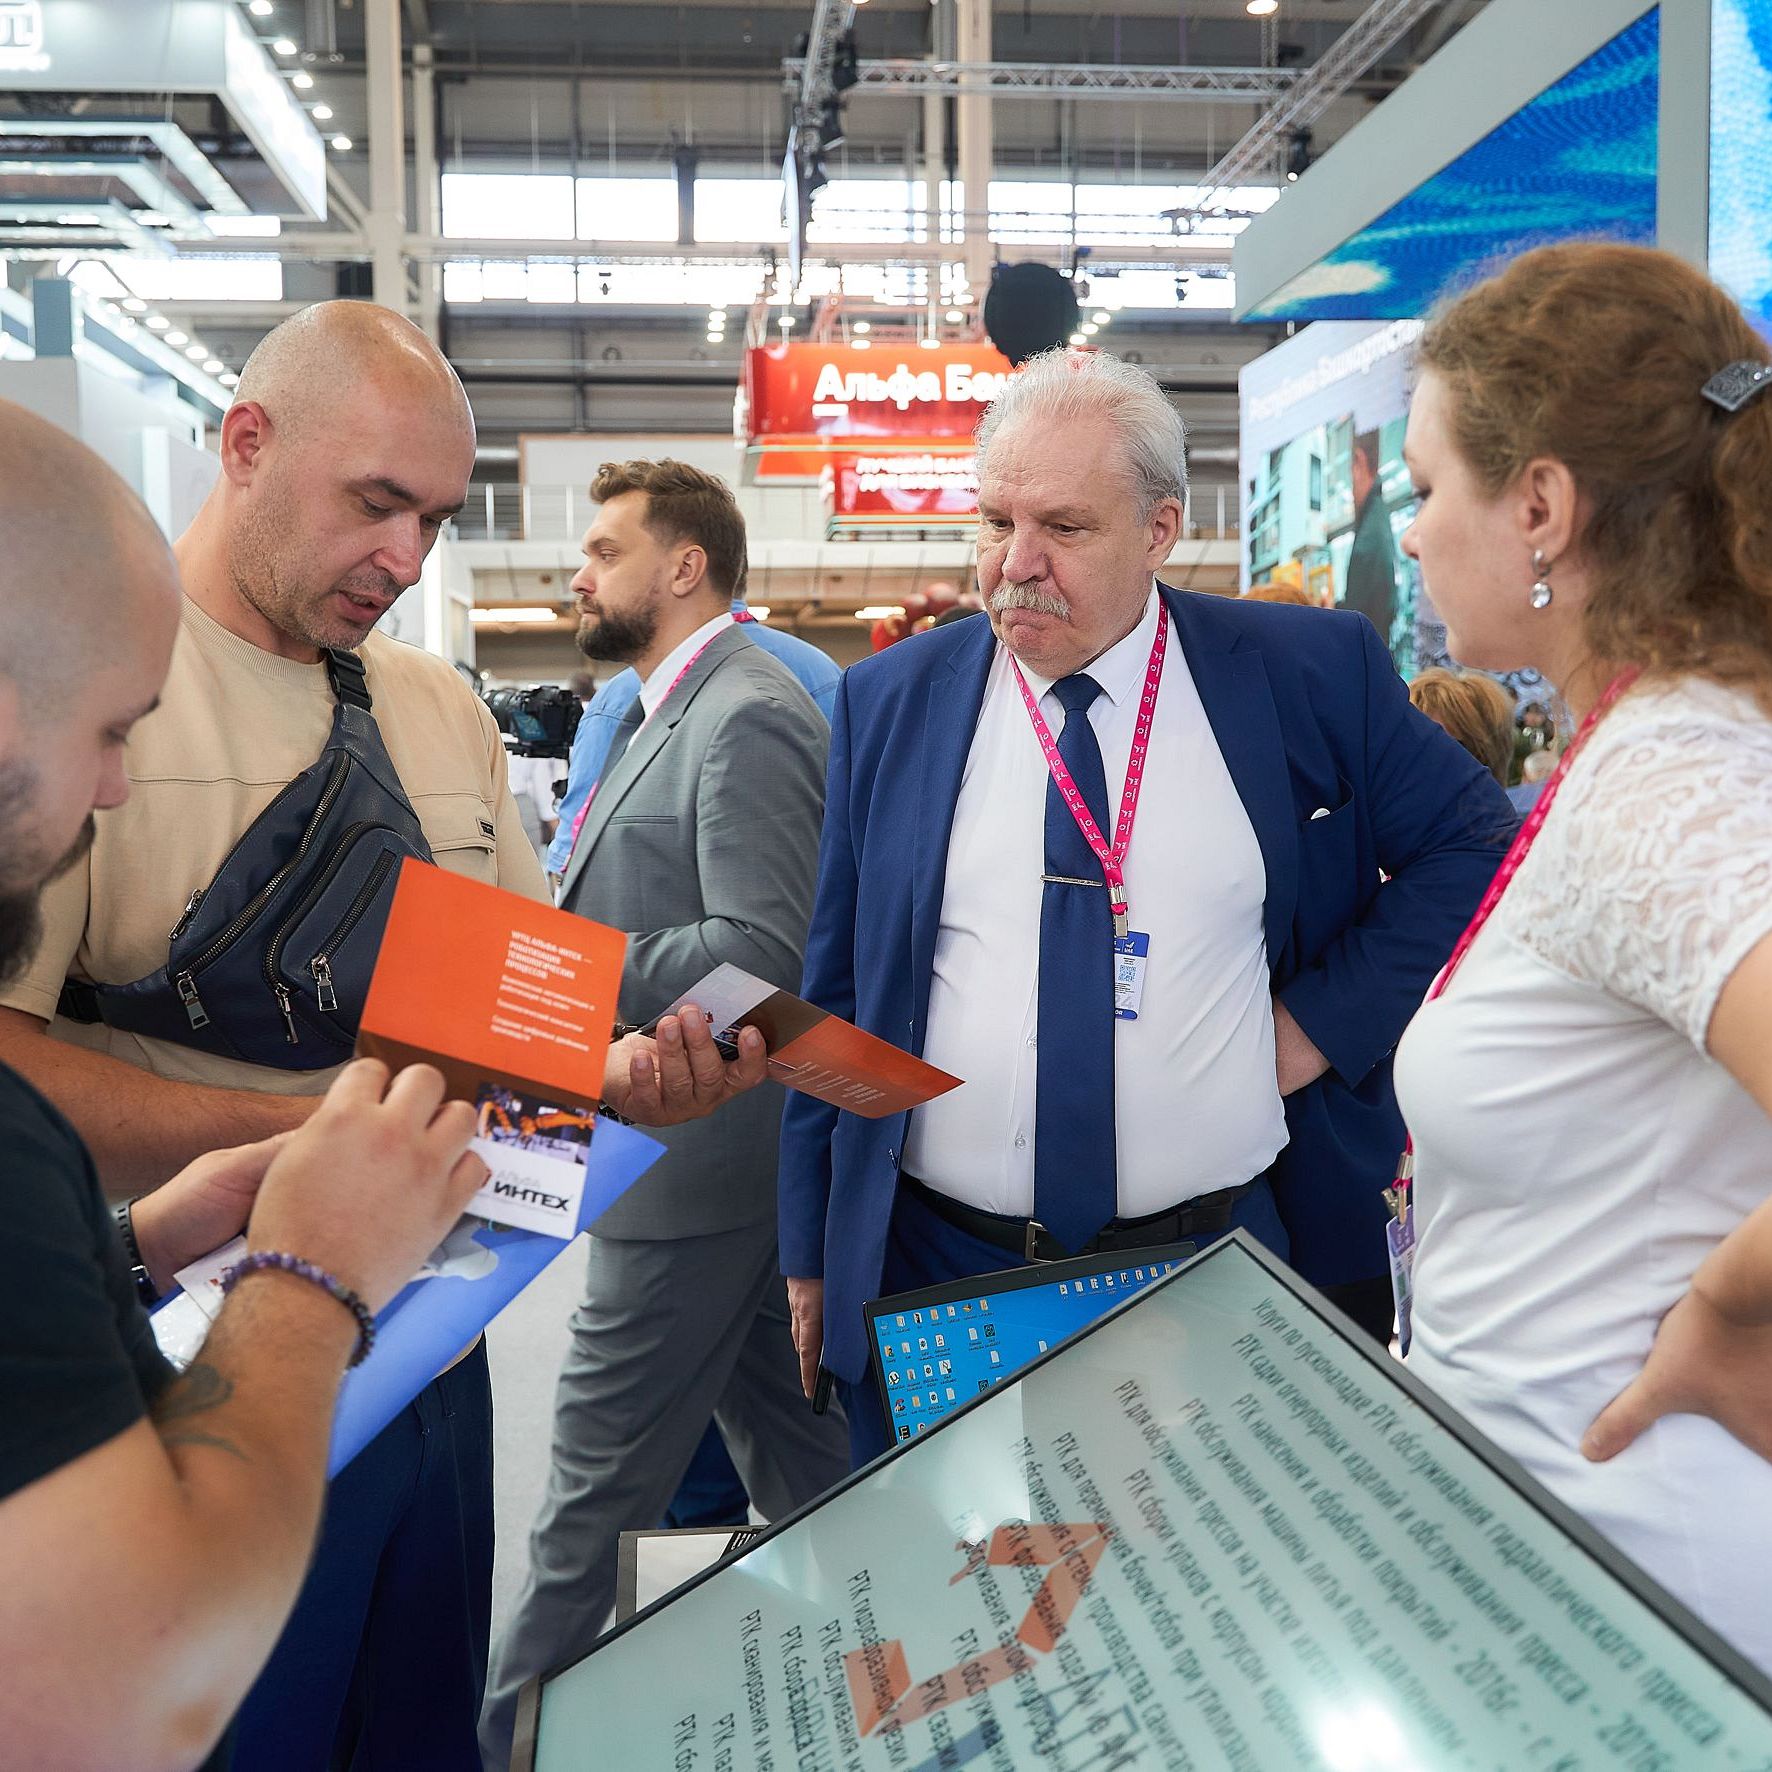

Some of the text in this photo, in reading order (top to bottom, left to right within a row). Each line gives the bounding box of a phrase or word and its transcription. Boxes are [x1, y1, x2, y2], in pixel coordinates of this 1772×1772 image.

[812, 362, 1021, 412] Альфа Бан
[494, 1181, 570, 1213] ИНТЕХ
[1232, 1333, 1263, 1360] РТК
[1251, 1296, 1290, 1334] Услуги
[1293, 1341, 1373, 1412] пусконаладке
[1363, 1403, 1400, 1435] РТК
[1113, 1379, 1143, 1407] РТК
[1230, 1392, 1263, 1423] РТК
[1124, 1402, 1153, 1426] для
[1178, 1397, 1211, 1427] РТК
[1051, 1431, 1080, 1460] РТК
[1059, 1456, 1087, 1481] для
[1141, 1422, 1208, 1504] обслуживания
[1123, 1468, 1154, 1500] РТК
[998, 1518, 1031, 1548] РТК
[1075, 1478, 1134, 1561] перемещения
[1137, 1495, 1177, 1542] сборки
[847, 1569, 872, 1601] РТК
[739, 1608, 762, 1641] РТК
[779, 1624, 804, 1658] РТК
[817, 1618, 843, 1652] РТК
[852, 1597, 903, 1722] гидроабразивной
[952, 1627, 980, 1664] РТК
[741, 1638, 770, 1736] сканирования
[823, 1649, 867, 1756] обслуживания
[917, 1673, 948, 1714] РТК
[673, 1713, 697, 1750] РТК
[712, 1712, 736, 1749] РТК
